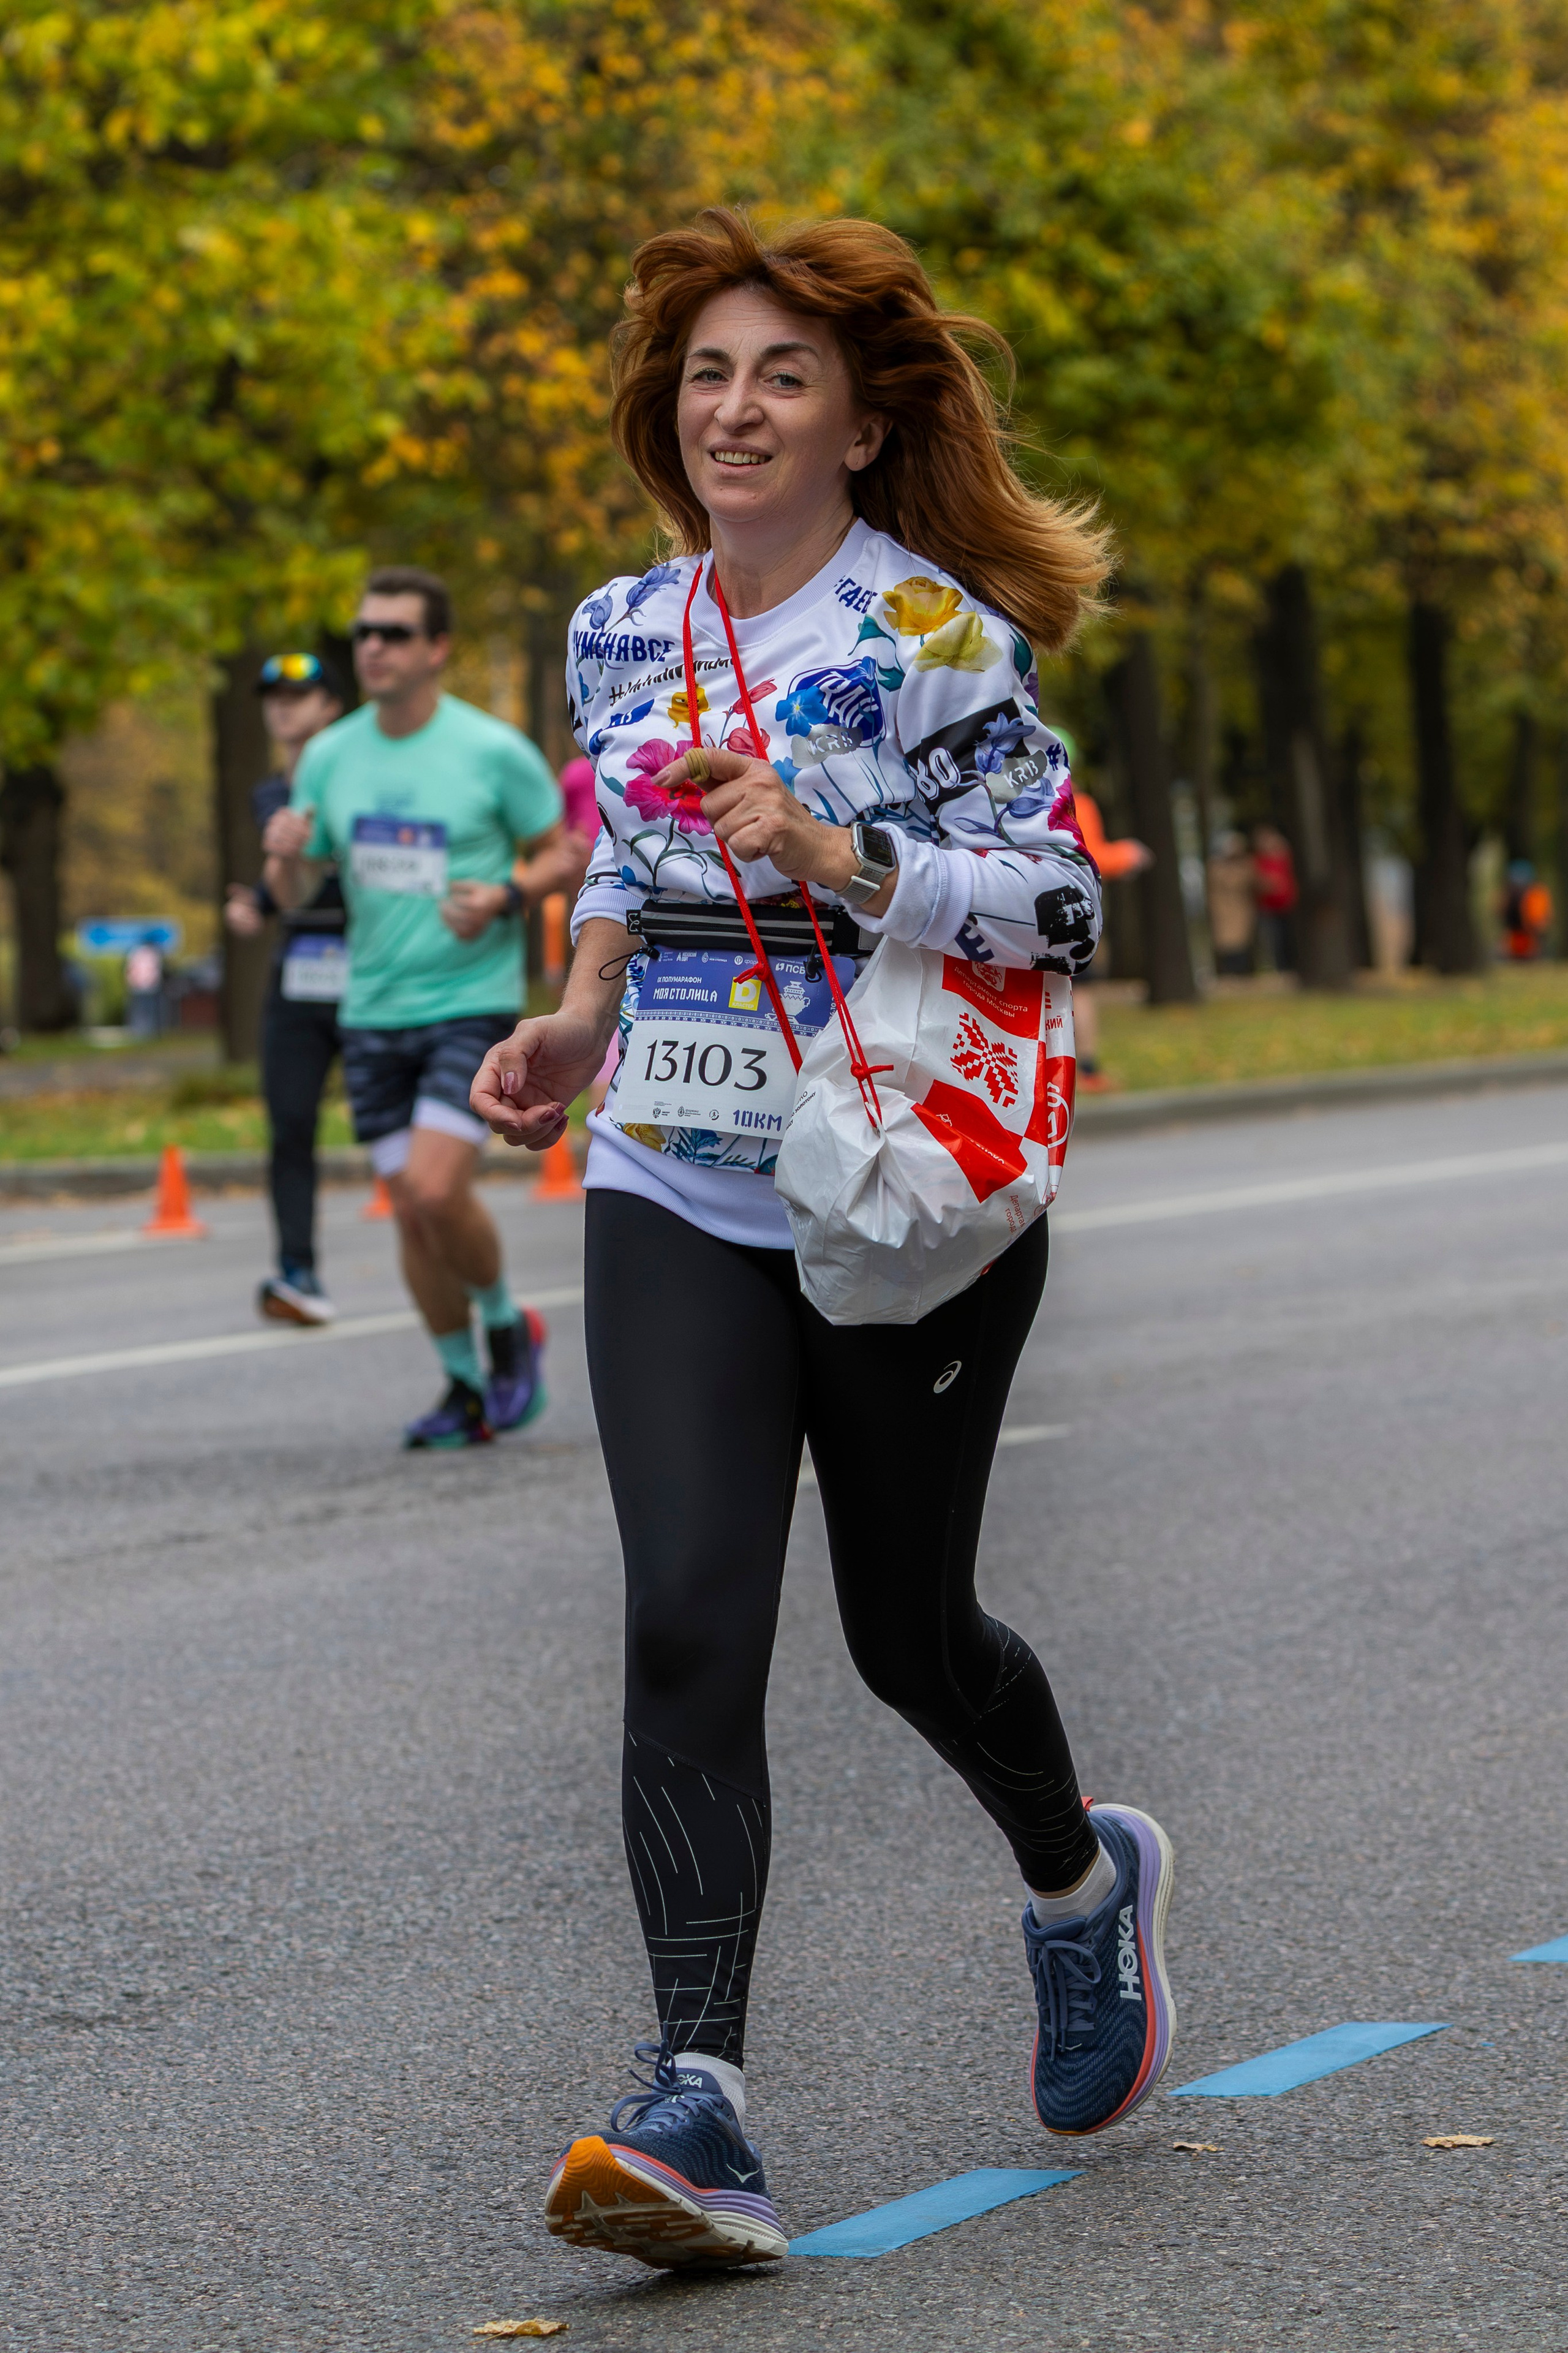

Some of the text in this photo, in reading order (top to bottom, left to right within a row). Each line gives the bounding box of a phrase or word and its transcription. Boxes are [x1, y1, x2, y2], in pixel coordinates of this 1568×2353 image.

[785, 964, 805, 975] ПСБ
[653, 988, 718, 1002] МОЯ СТОЛИЦА
[734, 981, 756, 1002] D
[954, 966, 1028, 1012] Департамент спорта
[963, 980, 1015, 1018] города Москвы
[644, 1039, 767, 1090] 13103
[733, 1109, 782, 1132] 10КМ
[1118, 1905, 1142, 2001] HOKA
[677, 2074, 703, 2088] OKA
